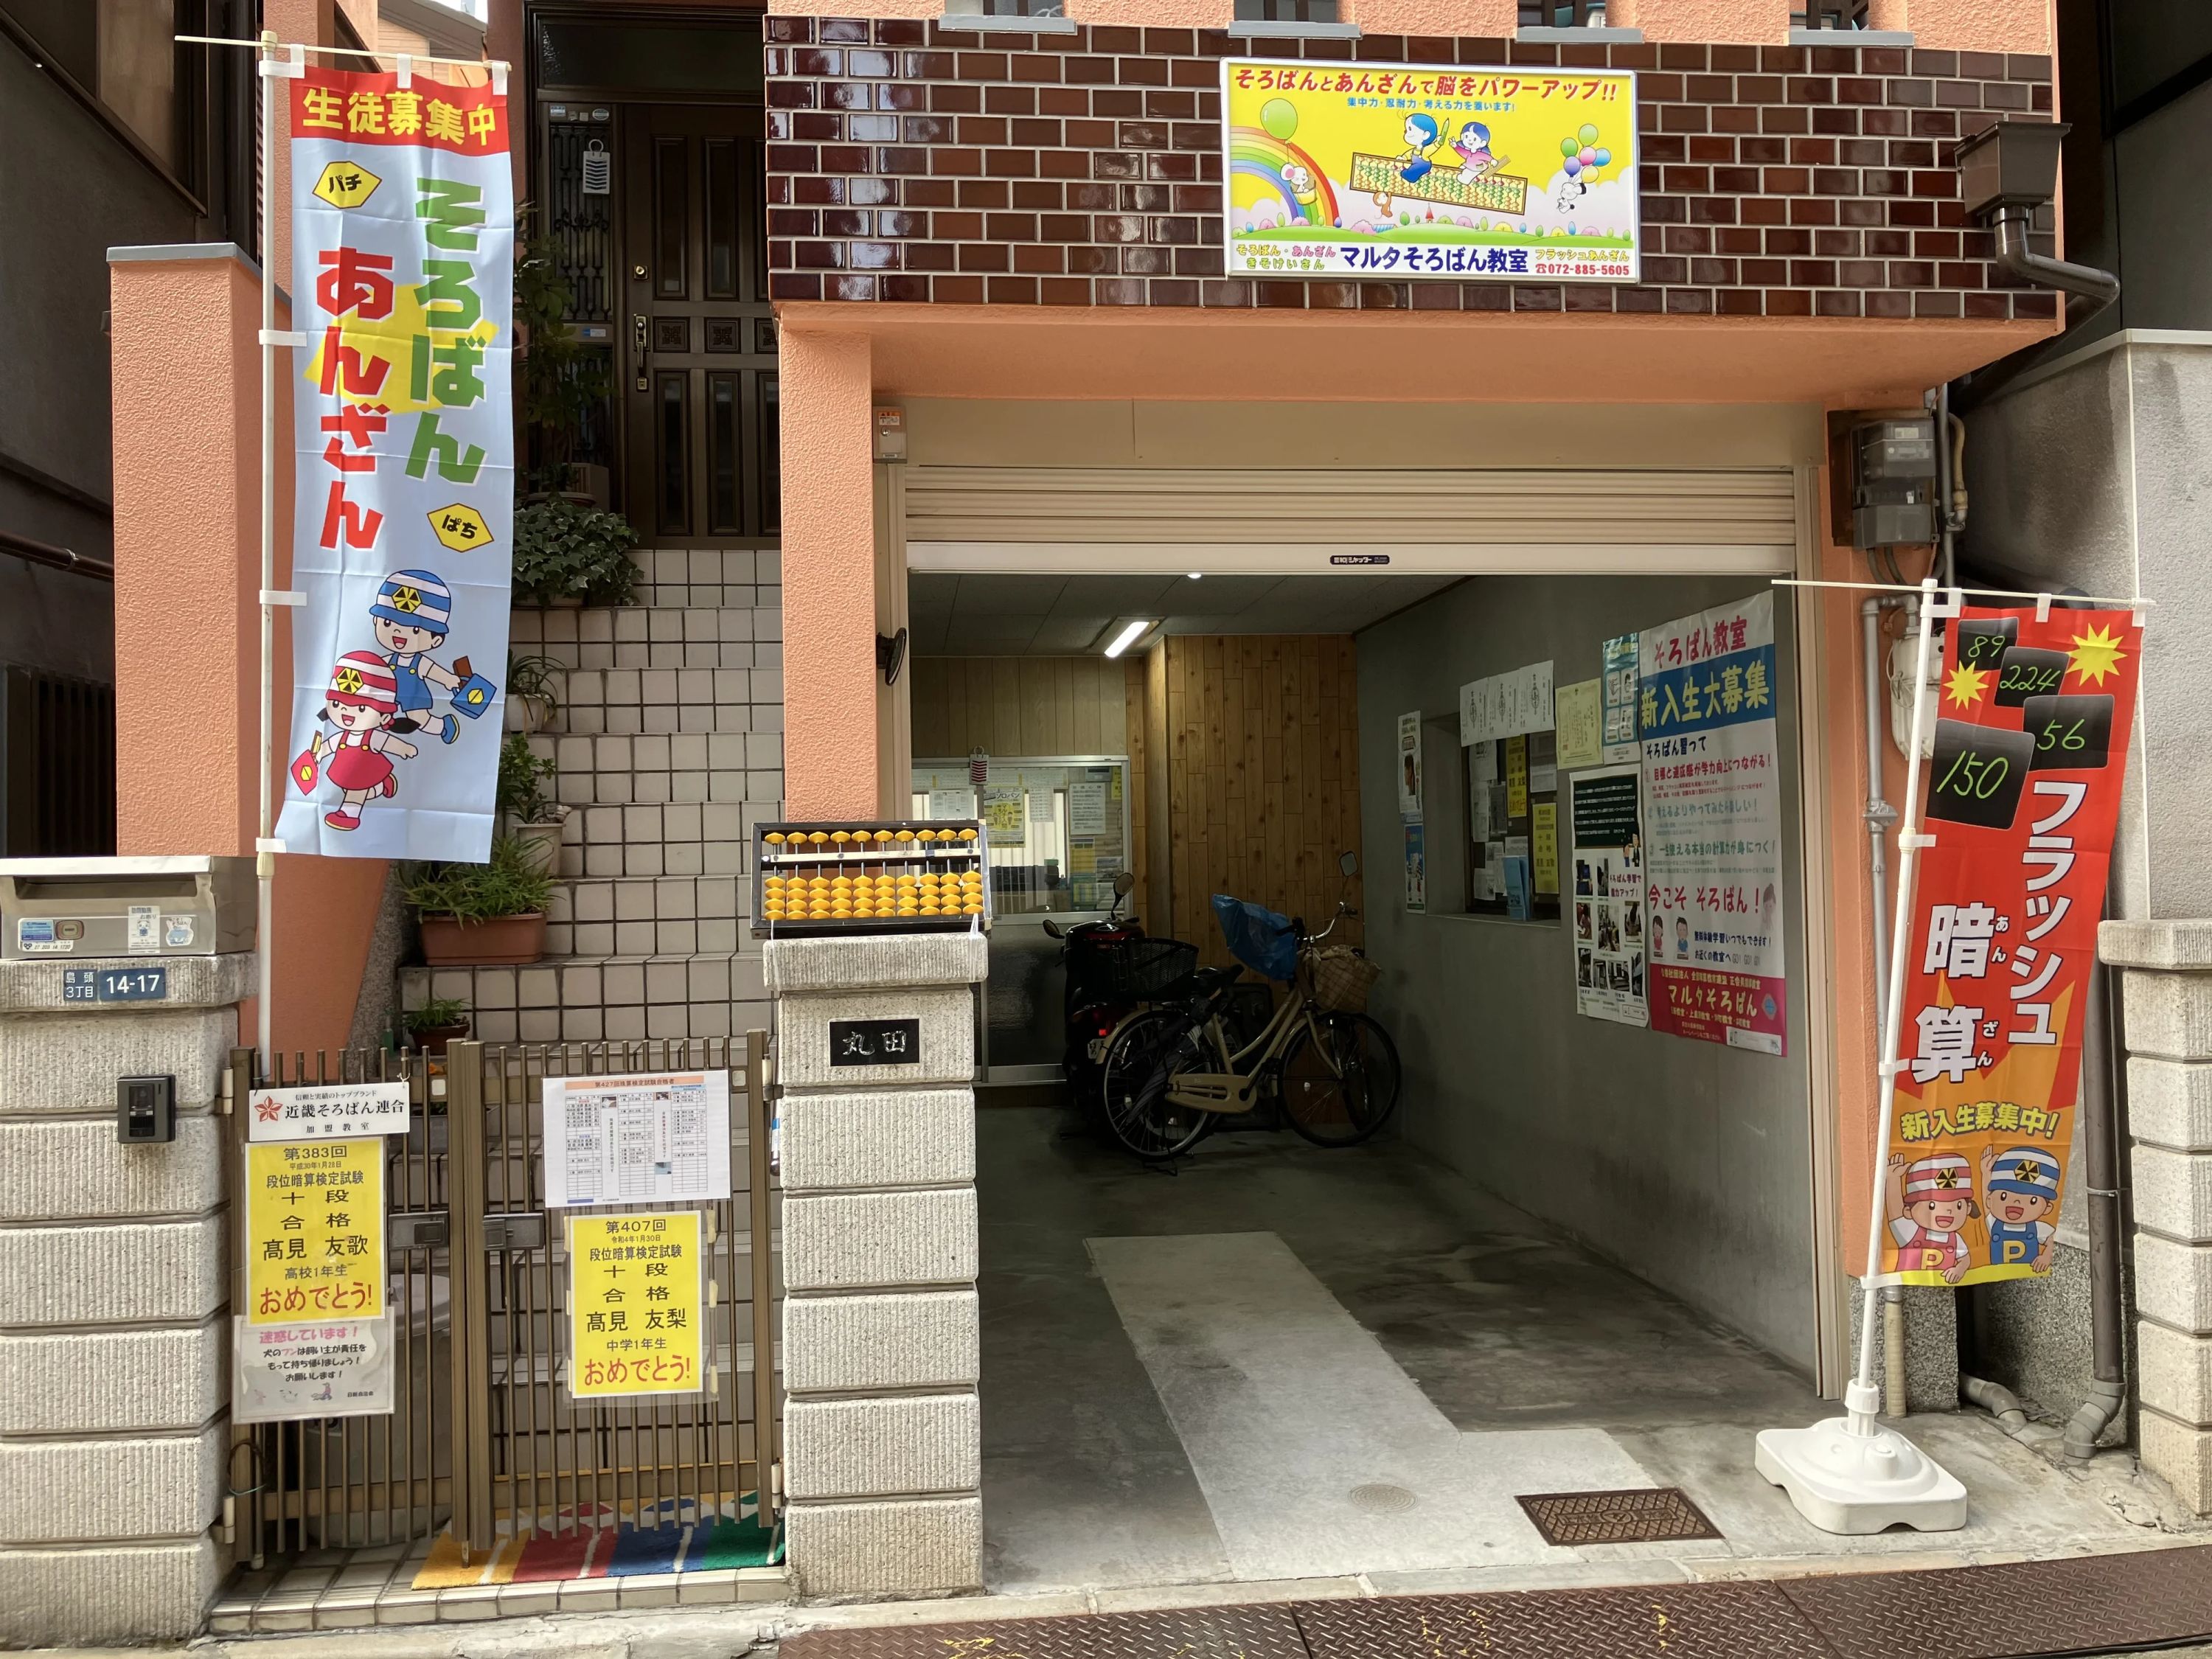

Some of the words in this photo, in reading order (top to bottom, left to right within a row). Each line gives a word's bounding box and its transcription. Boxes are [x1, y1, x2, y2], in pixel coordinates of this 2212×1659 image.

[1236, 69, 1617, 101] そろばんとあんざんで脳をパワーアップ!!
[302, 87, 496, 145] 生徒募集中
[329, 173, 362, 194] パチ
[1247, 257, 1324, 270] きそけいさん
[1340, 246, 1528, 273] マルタそろばん教室
[1535, 249, 1630, 262] フラッシュあんざん
[405, 177, 487, 484] そろばん
[316, 246, 394, 549] あんざん
[442, 514, 478, 539] ぱち
[1655, 615, 1747, 669] そろばん教室
[1968, 636, 2006, 658] 89
[1999, 665, 2061, 692] 224
[1641, 659, 1769, 729] 新入生大募集
[1646, 736, 1707, 759] そろばん習って
[2037, 719, 2085, 751] 56
[1936, 750, 2008, 799] 150
[1649, 883, 1687, 911] 今こそ
[2008, 780, 2088, 1045] フラッシュ
[66, 972, 94, 984] 島頭
[106, 975, 160, 993] 14-17
[66, 986, 94, 998] 3丁目
[1668, 985, 1757, 1017] マルタそろばん
[1911, 902, 1995, 1083] 暗算
[842, 1030, 907, 1057] 丸田
[285, 1099, 405, 1119] 近畿そろばん連合
[1900, 1101, 2061, 1141] 新入生募集中!
[284, 1145, 347, 1161] 第383回
[290, 1161, 341, 1170] 平成30年1月28日
[267, 1170, 364, 1189] 段位暗算検定試験
[606, 1219, 666, 1234] 第407回
[611, 1234, 661, 1244] 令和4年1月30日
[590, 1244, 682, 1262] 段位暗算検定試験
[285, 1264, 347, 1280] 高校1年生
[260, 1281, 372, 1315] おめでとう!
[260, 1326, 358, 1343] 迷惑しています!
[607, 1337, 667, 1352] 中学1年生
[585, 1354, 690, 1386] おめでとう!
